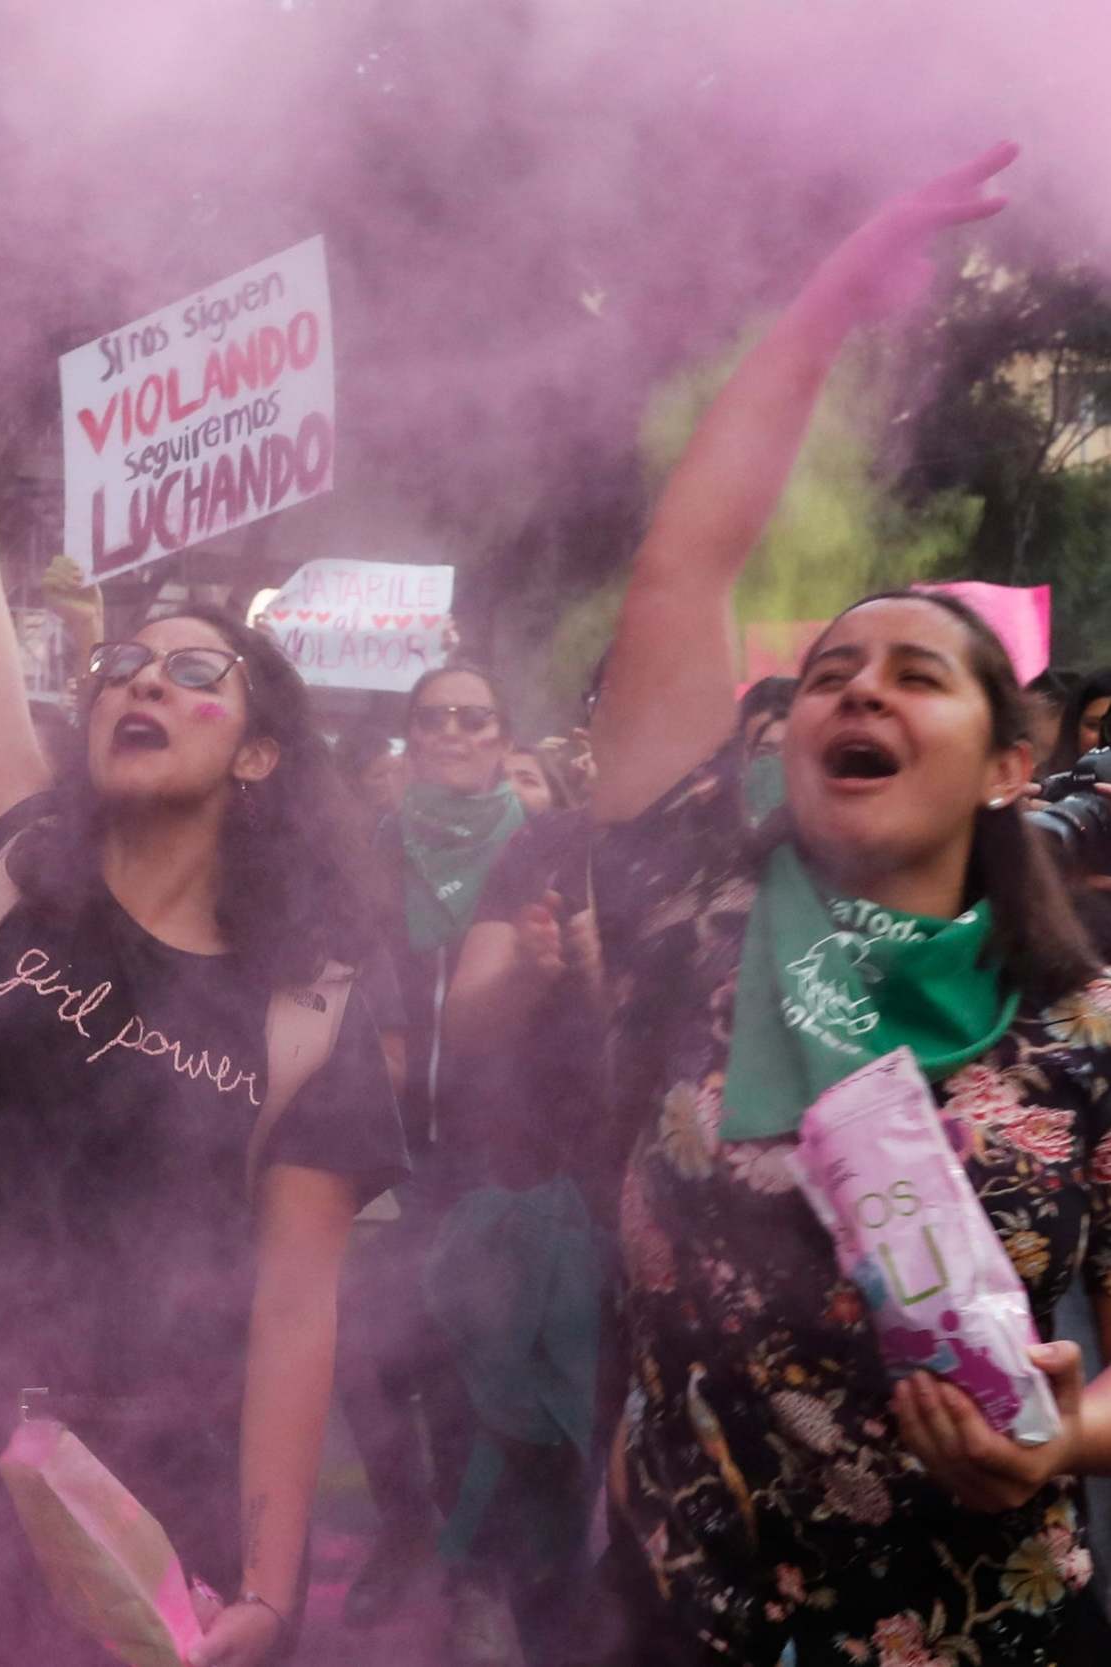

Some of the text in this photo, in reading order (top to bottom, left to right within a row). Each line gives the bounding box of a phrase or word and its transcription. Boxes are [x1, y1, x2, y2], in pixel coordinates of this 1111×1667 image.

[182, 270, 285, 342] siguen
[77, 311, 319, 456] VIOLANDO
[123, 389, 281, 482] seguiremos
[91, 411, 334, 575] LUCHANDO
[86, 1015, 261, 1106] power
